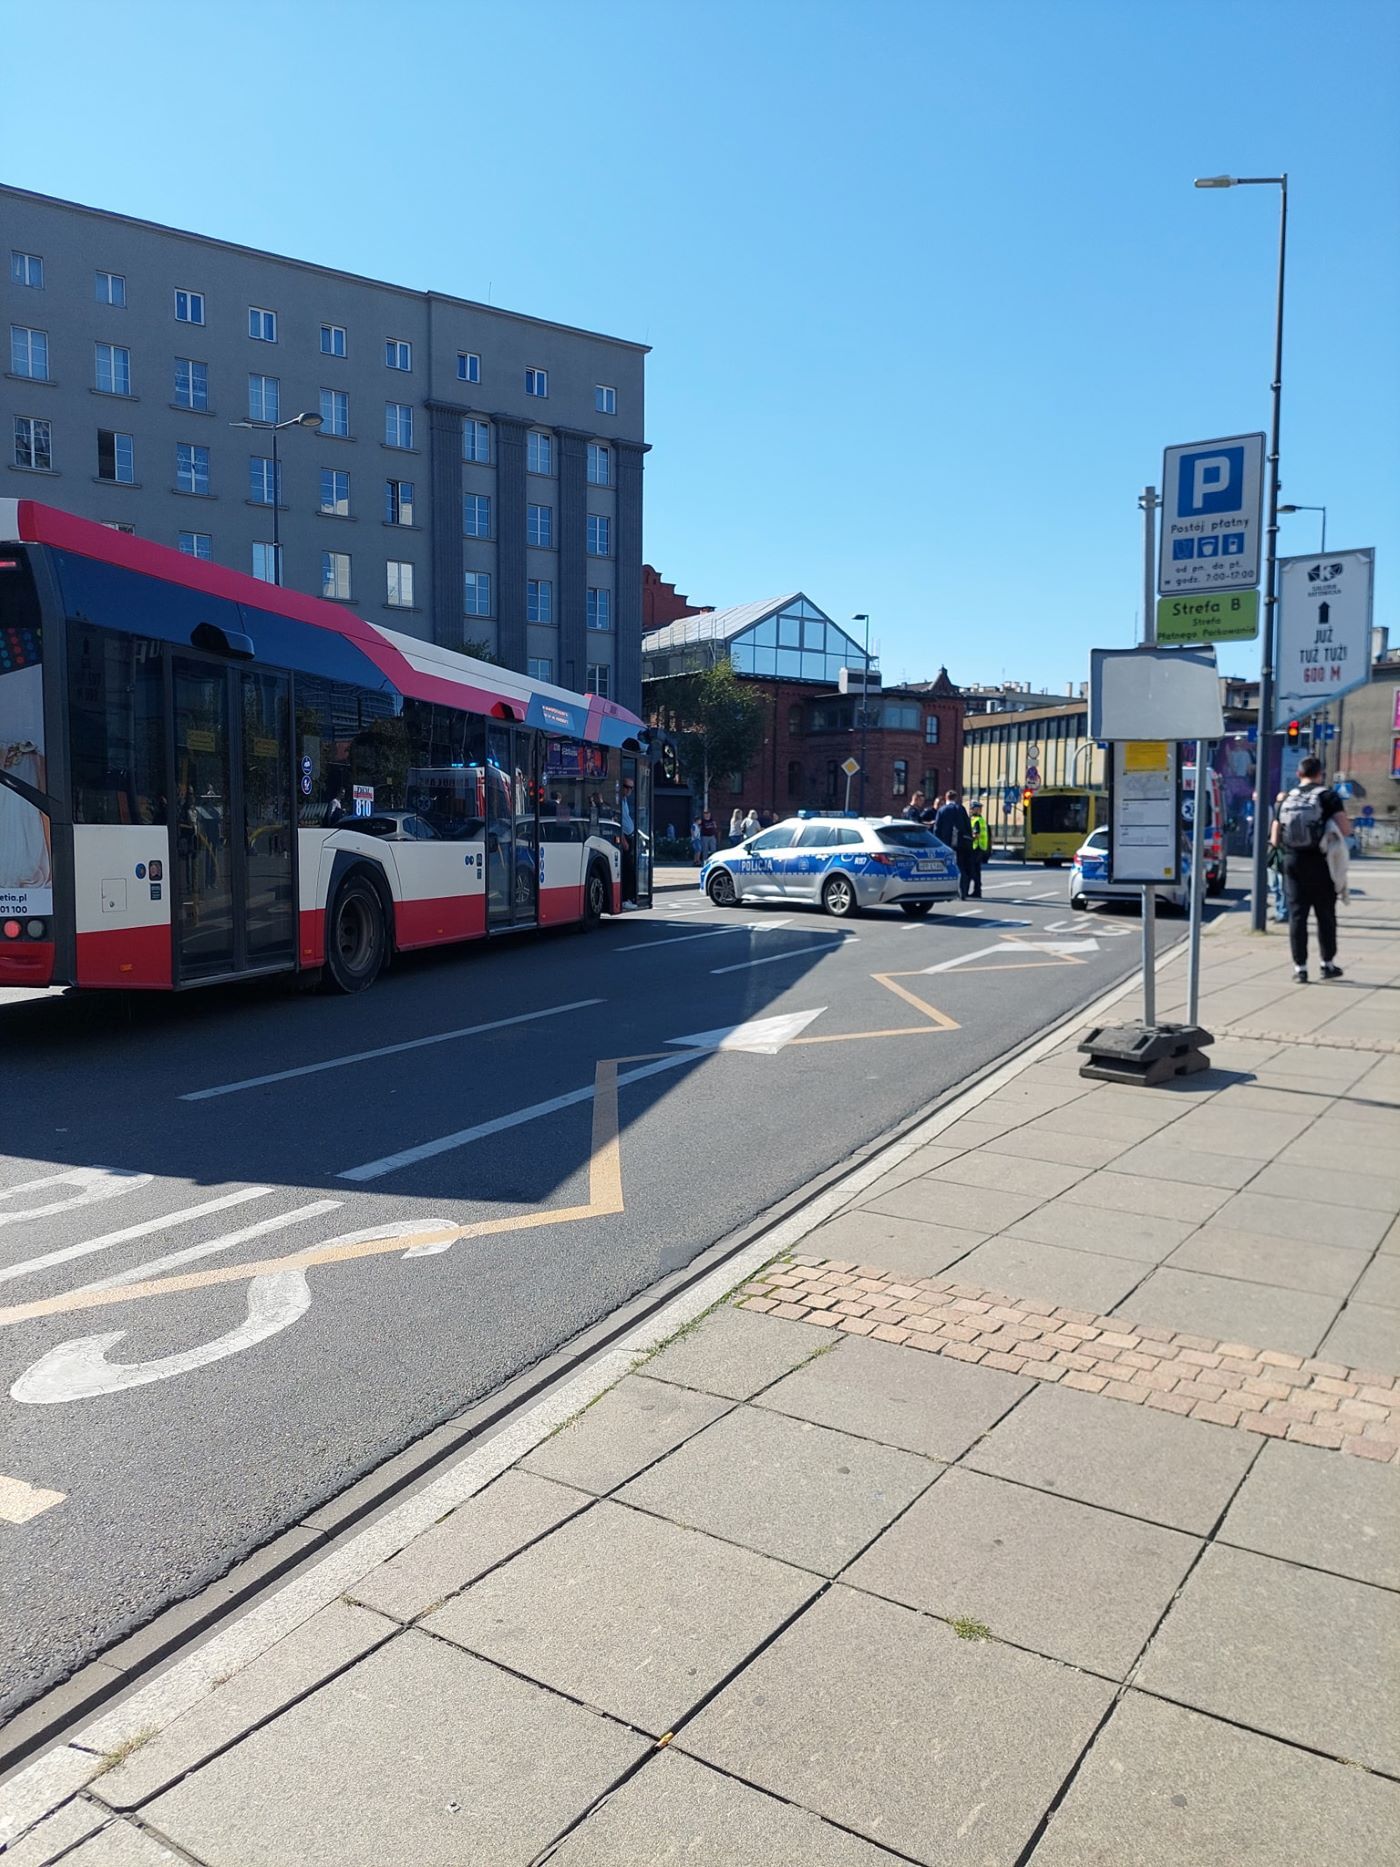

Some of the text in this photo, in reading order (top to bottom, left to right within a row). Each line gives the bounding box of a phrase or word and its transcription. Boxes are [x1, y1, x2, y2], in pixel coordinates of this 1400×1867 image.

[1193, 456, 1230, 508] P
[1171, 518, 1249, 534] Postój płatny
[1175, 564, 1187, 574] od
[1212, 561, 1224, 570] do
[1172, 597, 1241, 616] Strefa B
[1314, 625, 1333, 644] JUŻ
[1300, 646, 1319, 664] TUŻ
[1303, 664, 1341, 683] 600 M
[355, 799, 371, 817] 810
[741, 860, 774, 872] POLICJA
